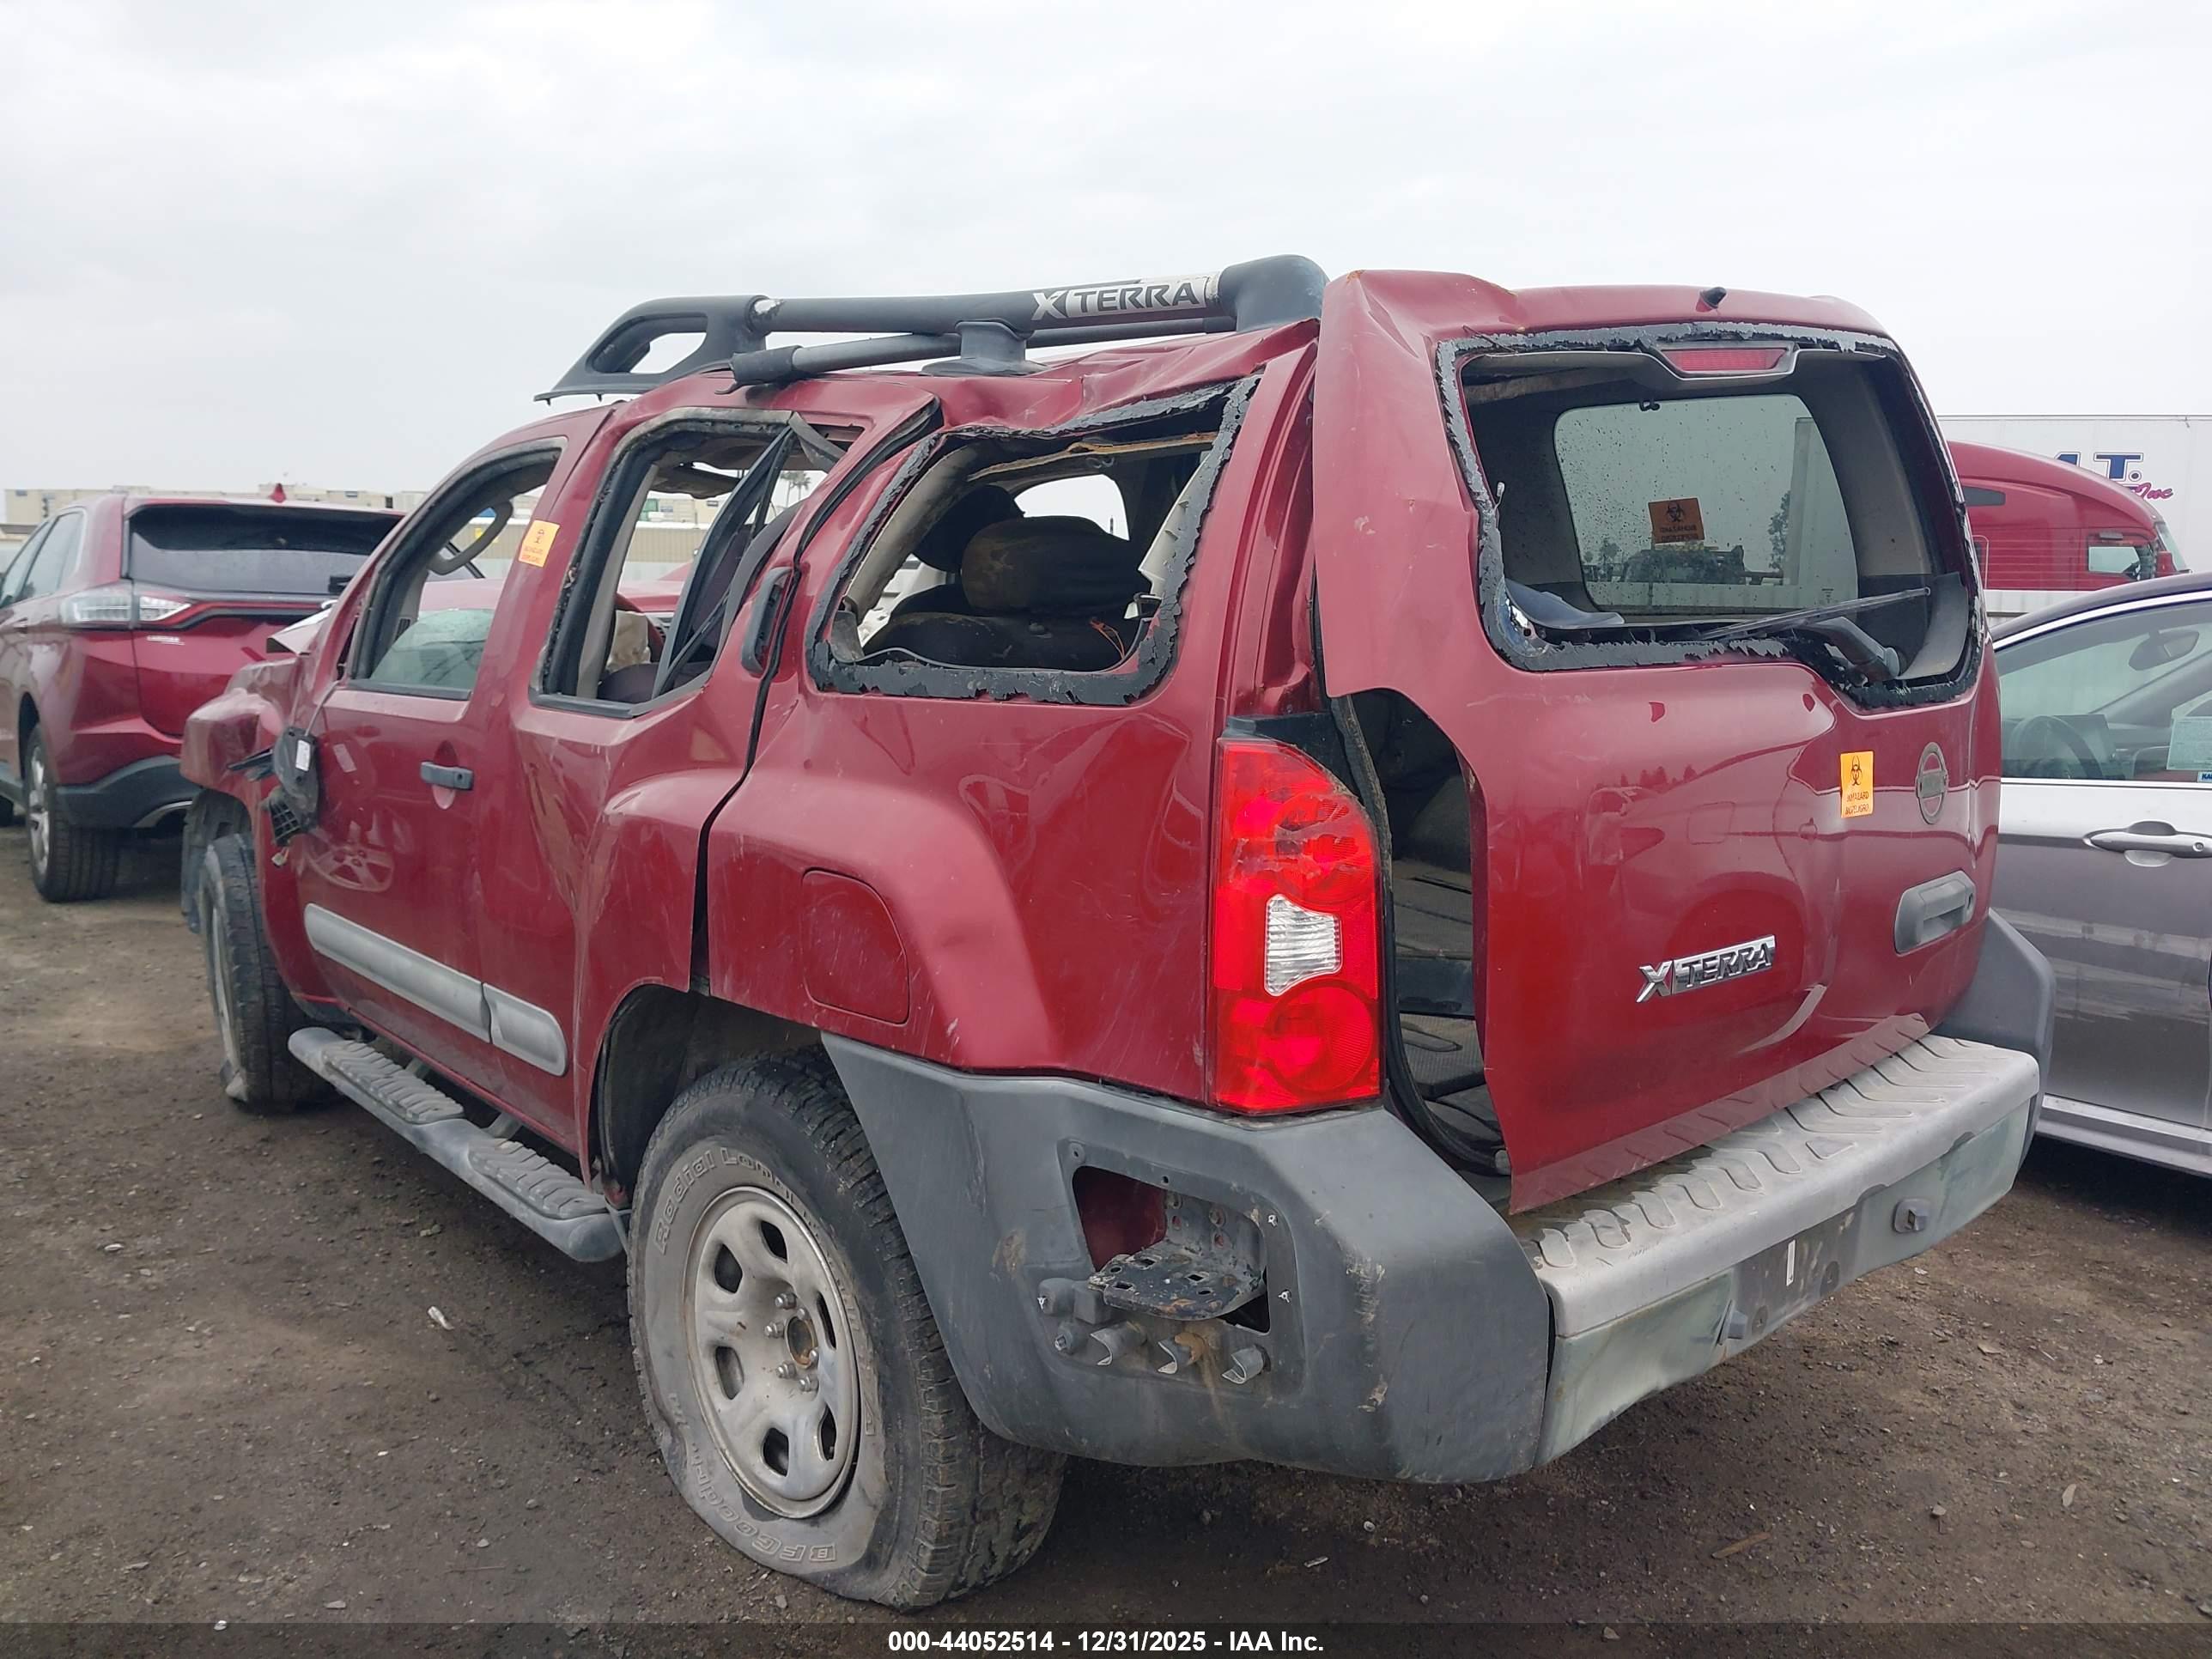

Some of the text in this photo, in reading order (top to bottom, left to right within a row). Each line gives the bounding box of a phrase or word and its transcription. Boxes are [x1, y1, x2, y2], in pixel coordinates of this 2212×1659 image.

[1032, 281, 1200, 320] XTERRA
[1636, 935, 1775, 1003] XTERRA
[654, 1150, 716, 1254] Radial
